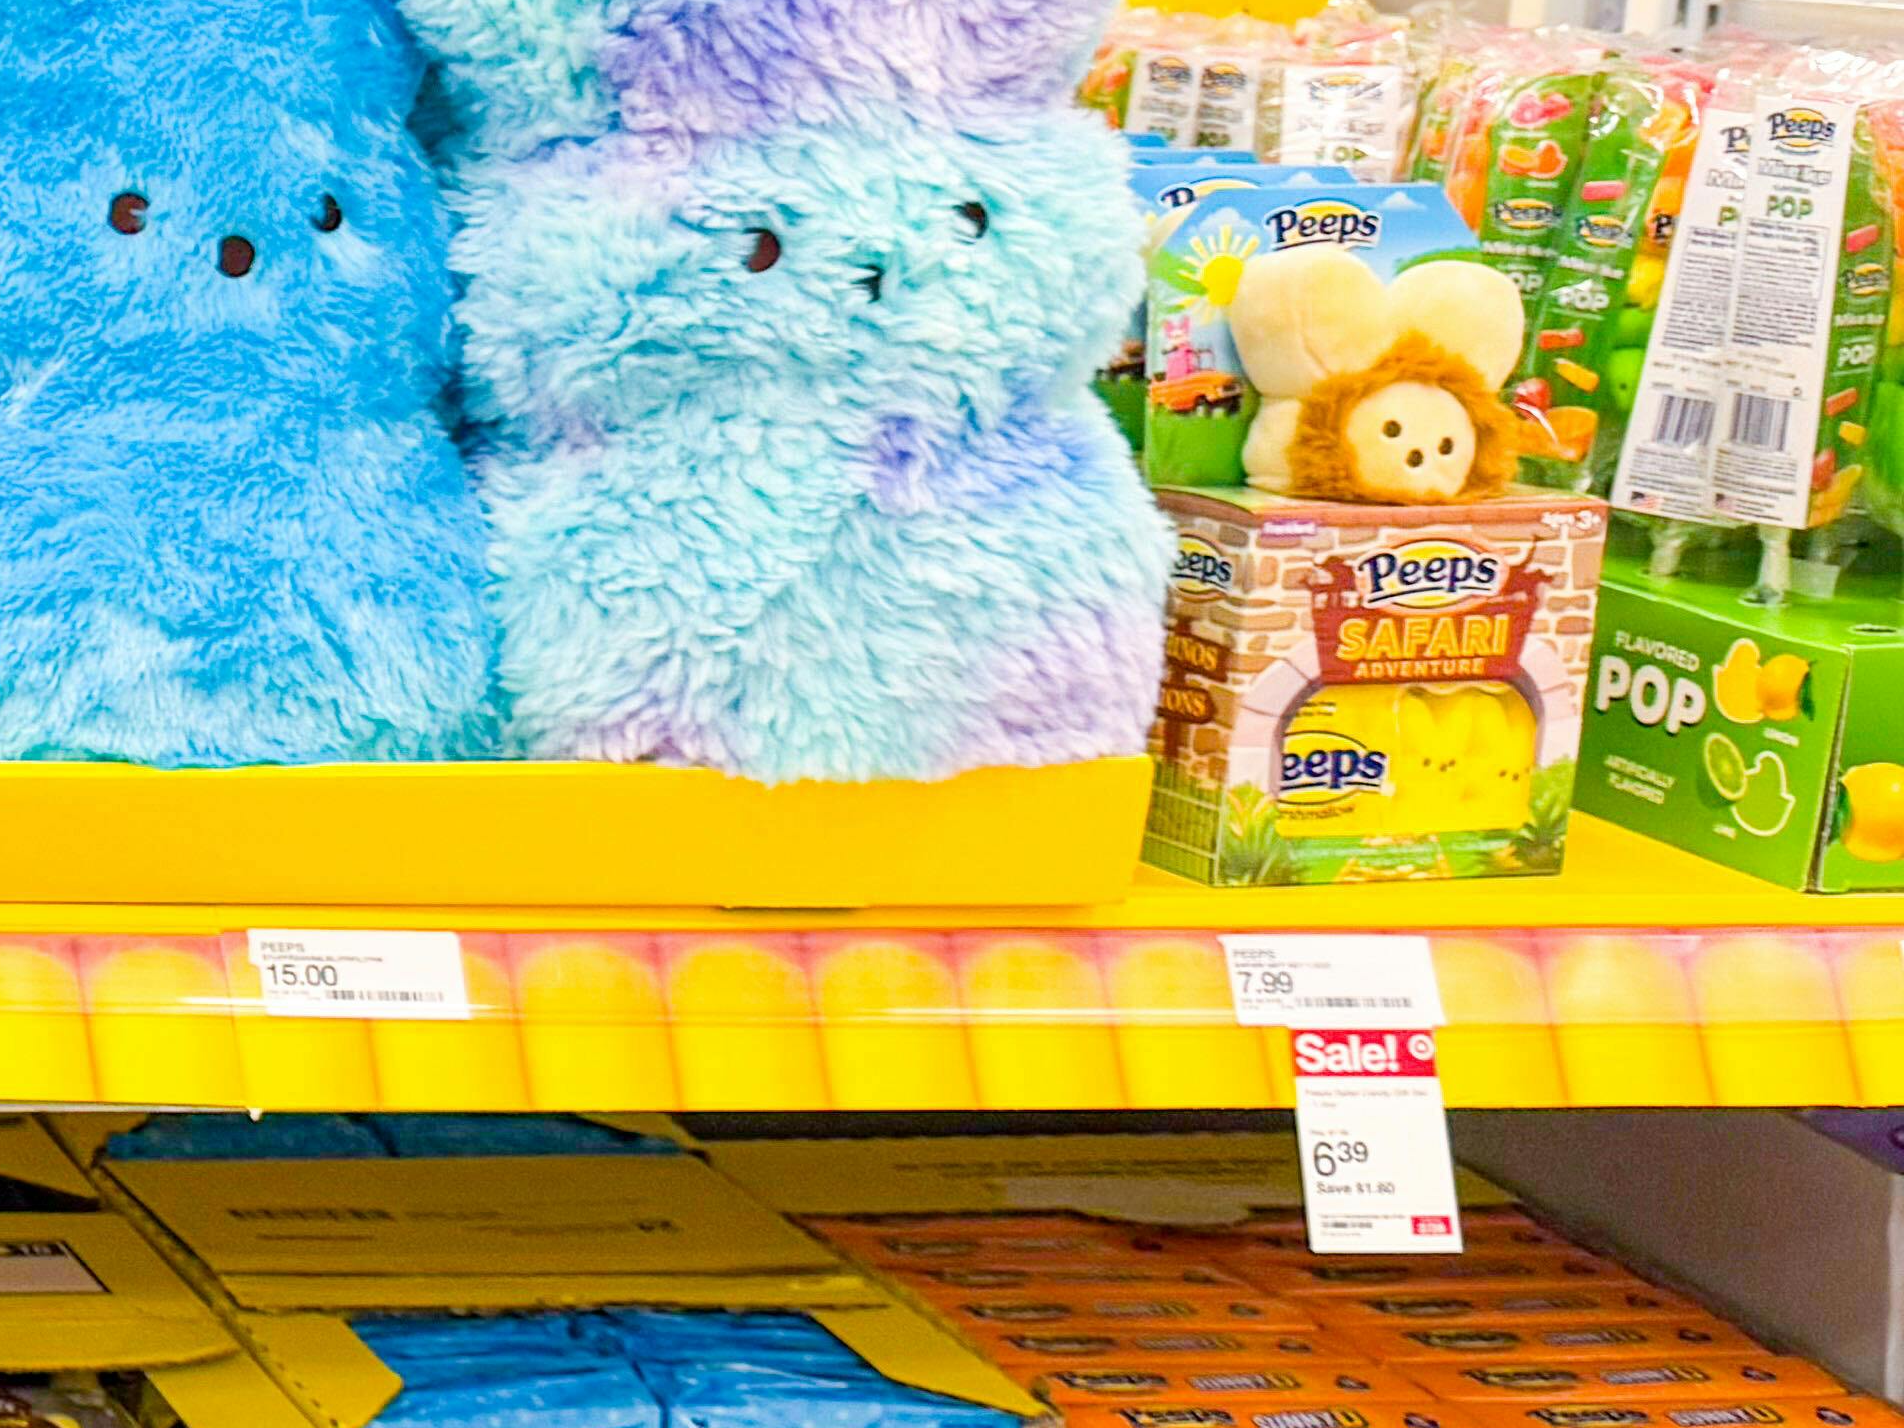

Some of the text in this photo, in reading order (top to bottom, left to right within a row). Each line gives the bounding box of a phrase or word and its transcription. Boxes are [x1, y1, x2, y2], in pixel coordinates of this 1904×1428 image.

[1766, 111, 1837, 139] Peeps
[1266, 204, 1380, 245] Peeps
[1765, 194, 1815, 220] POP
[1358, 552, 1499, 600] Peeps
[1336, 613, 1511, 663] SAFARI
[1615, 630, 1700, 672] FLAVORED
[1352, 657, 1487, 679] ADVENTURE
[1595, 654, 1707, 736] POP
[1282, 747, 1386, 792] eeps
[267, 964, 339, 987] 15.00
[1237, 971, 1293, 995] 7.99
[1295, 1033, 1401, 1073] Sale!
[1317, 1181, 1352, 1194] Save
